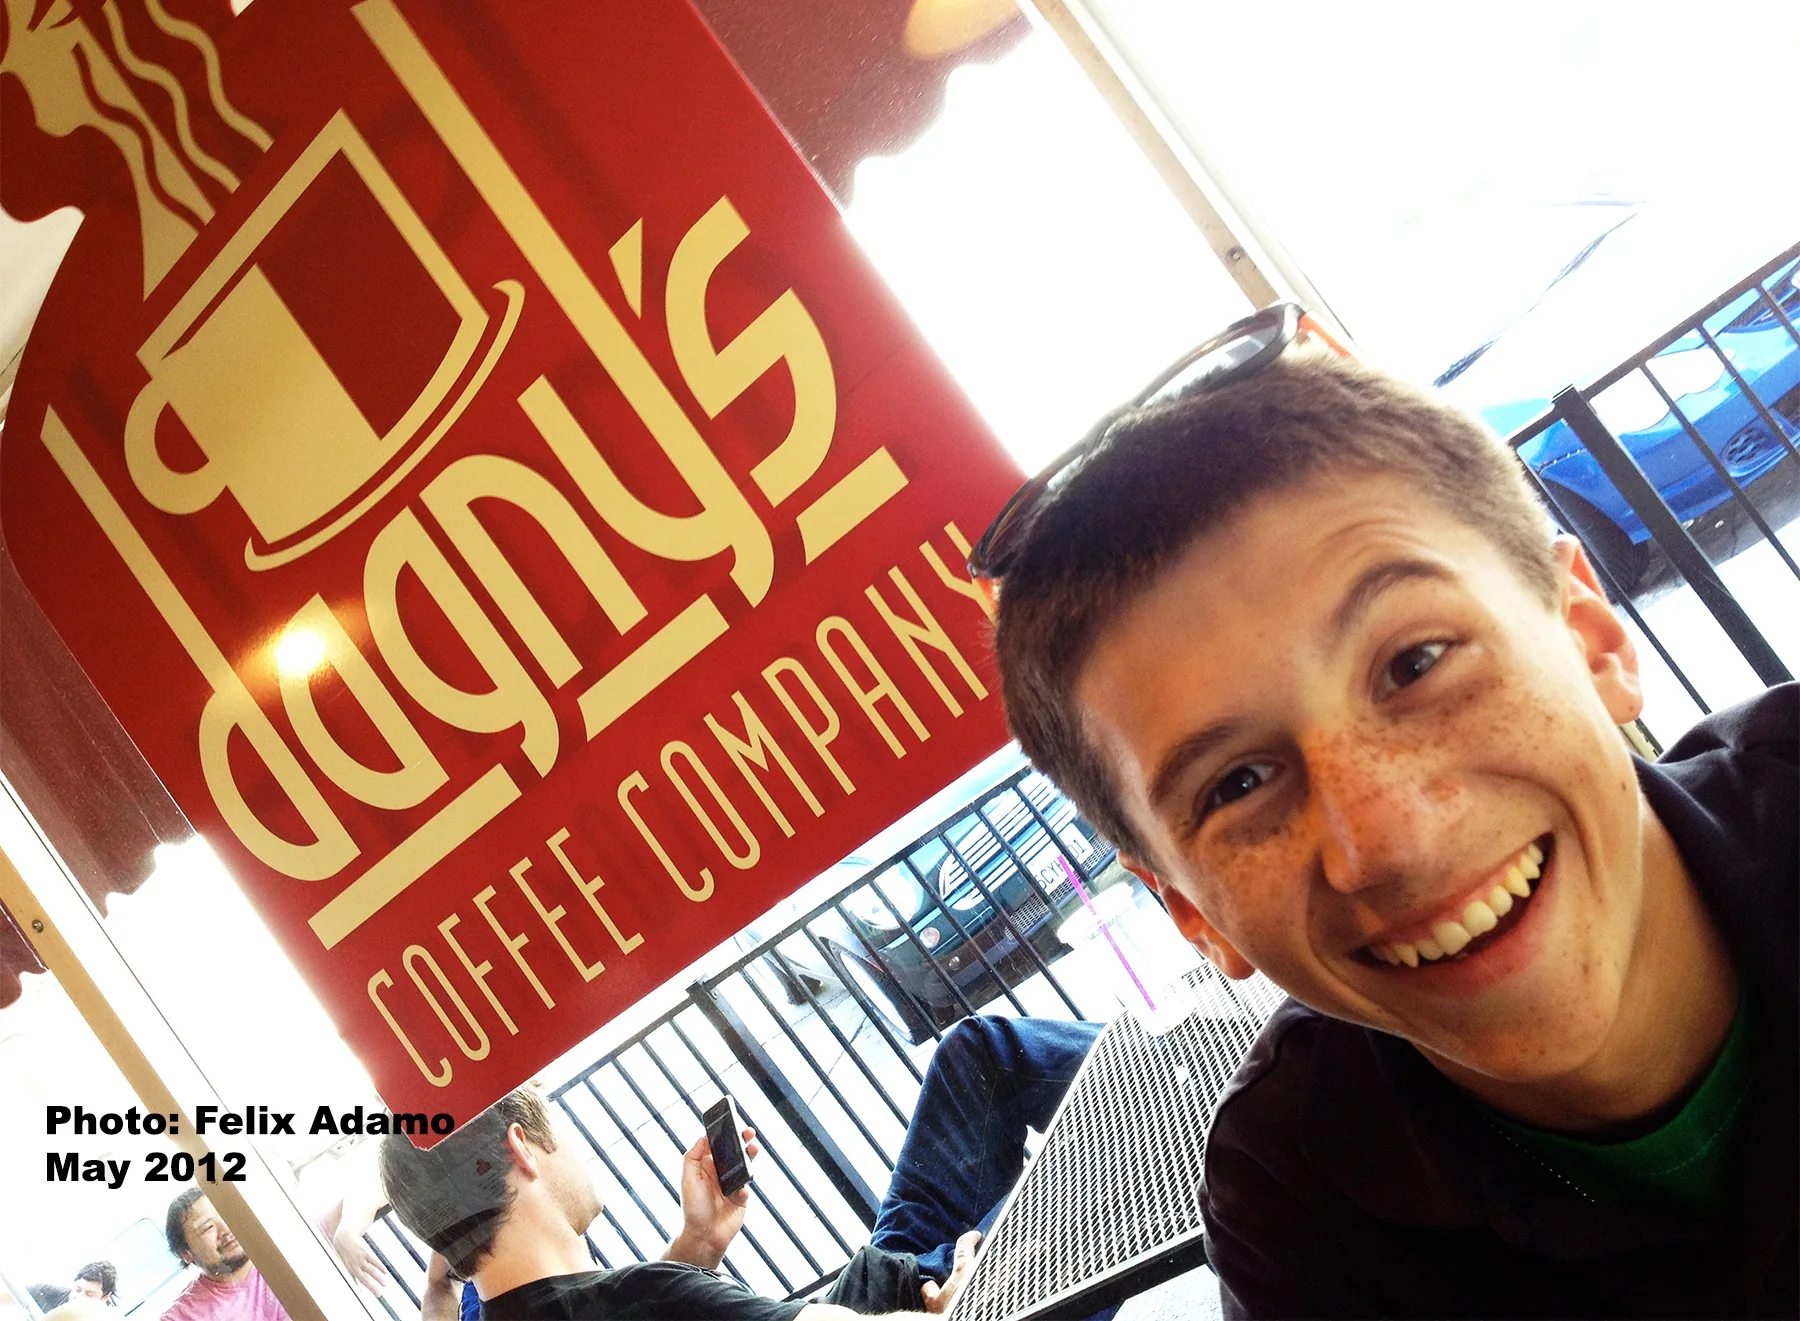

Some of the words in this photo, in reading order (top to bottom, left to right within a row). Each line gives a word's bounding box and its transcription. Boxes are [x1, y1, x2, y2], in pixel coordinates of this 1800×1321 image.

[42, 0, 837, 881] dagny's
[368, 828, 645, 1088] COFFEE
[618, 521, 1001, 903] COMPANY
